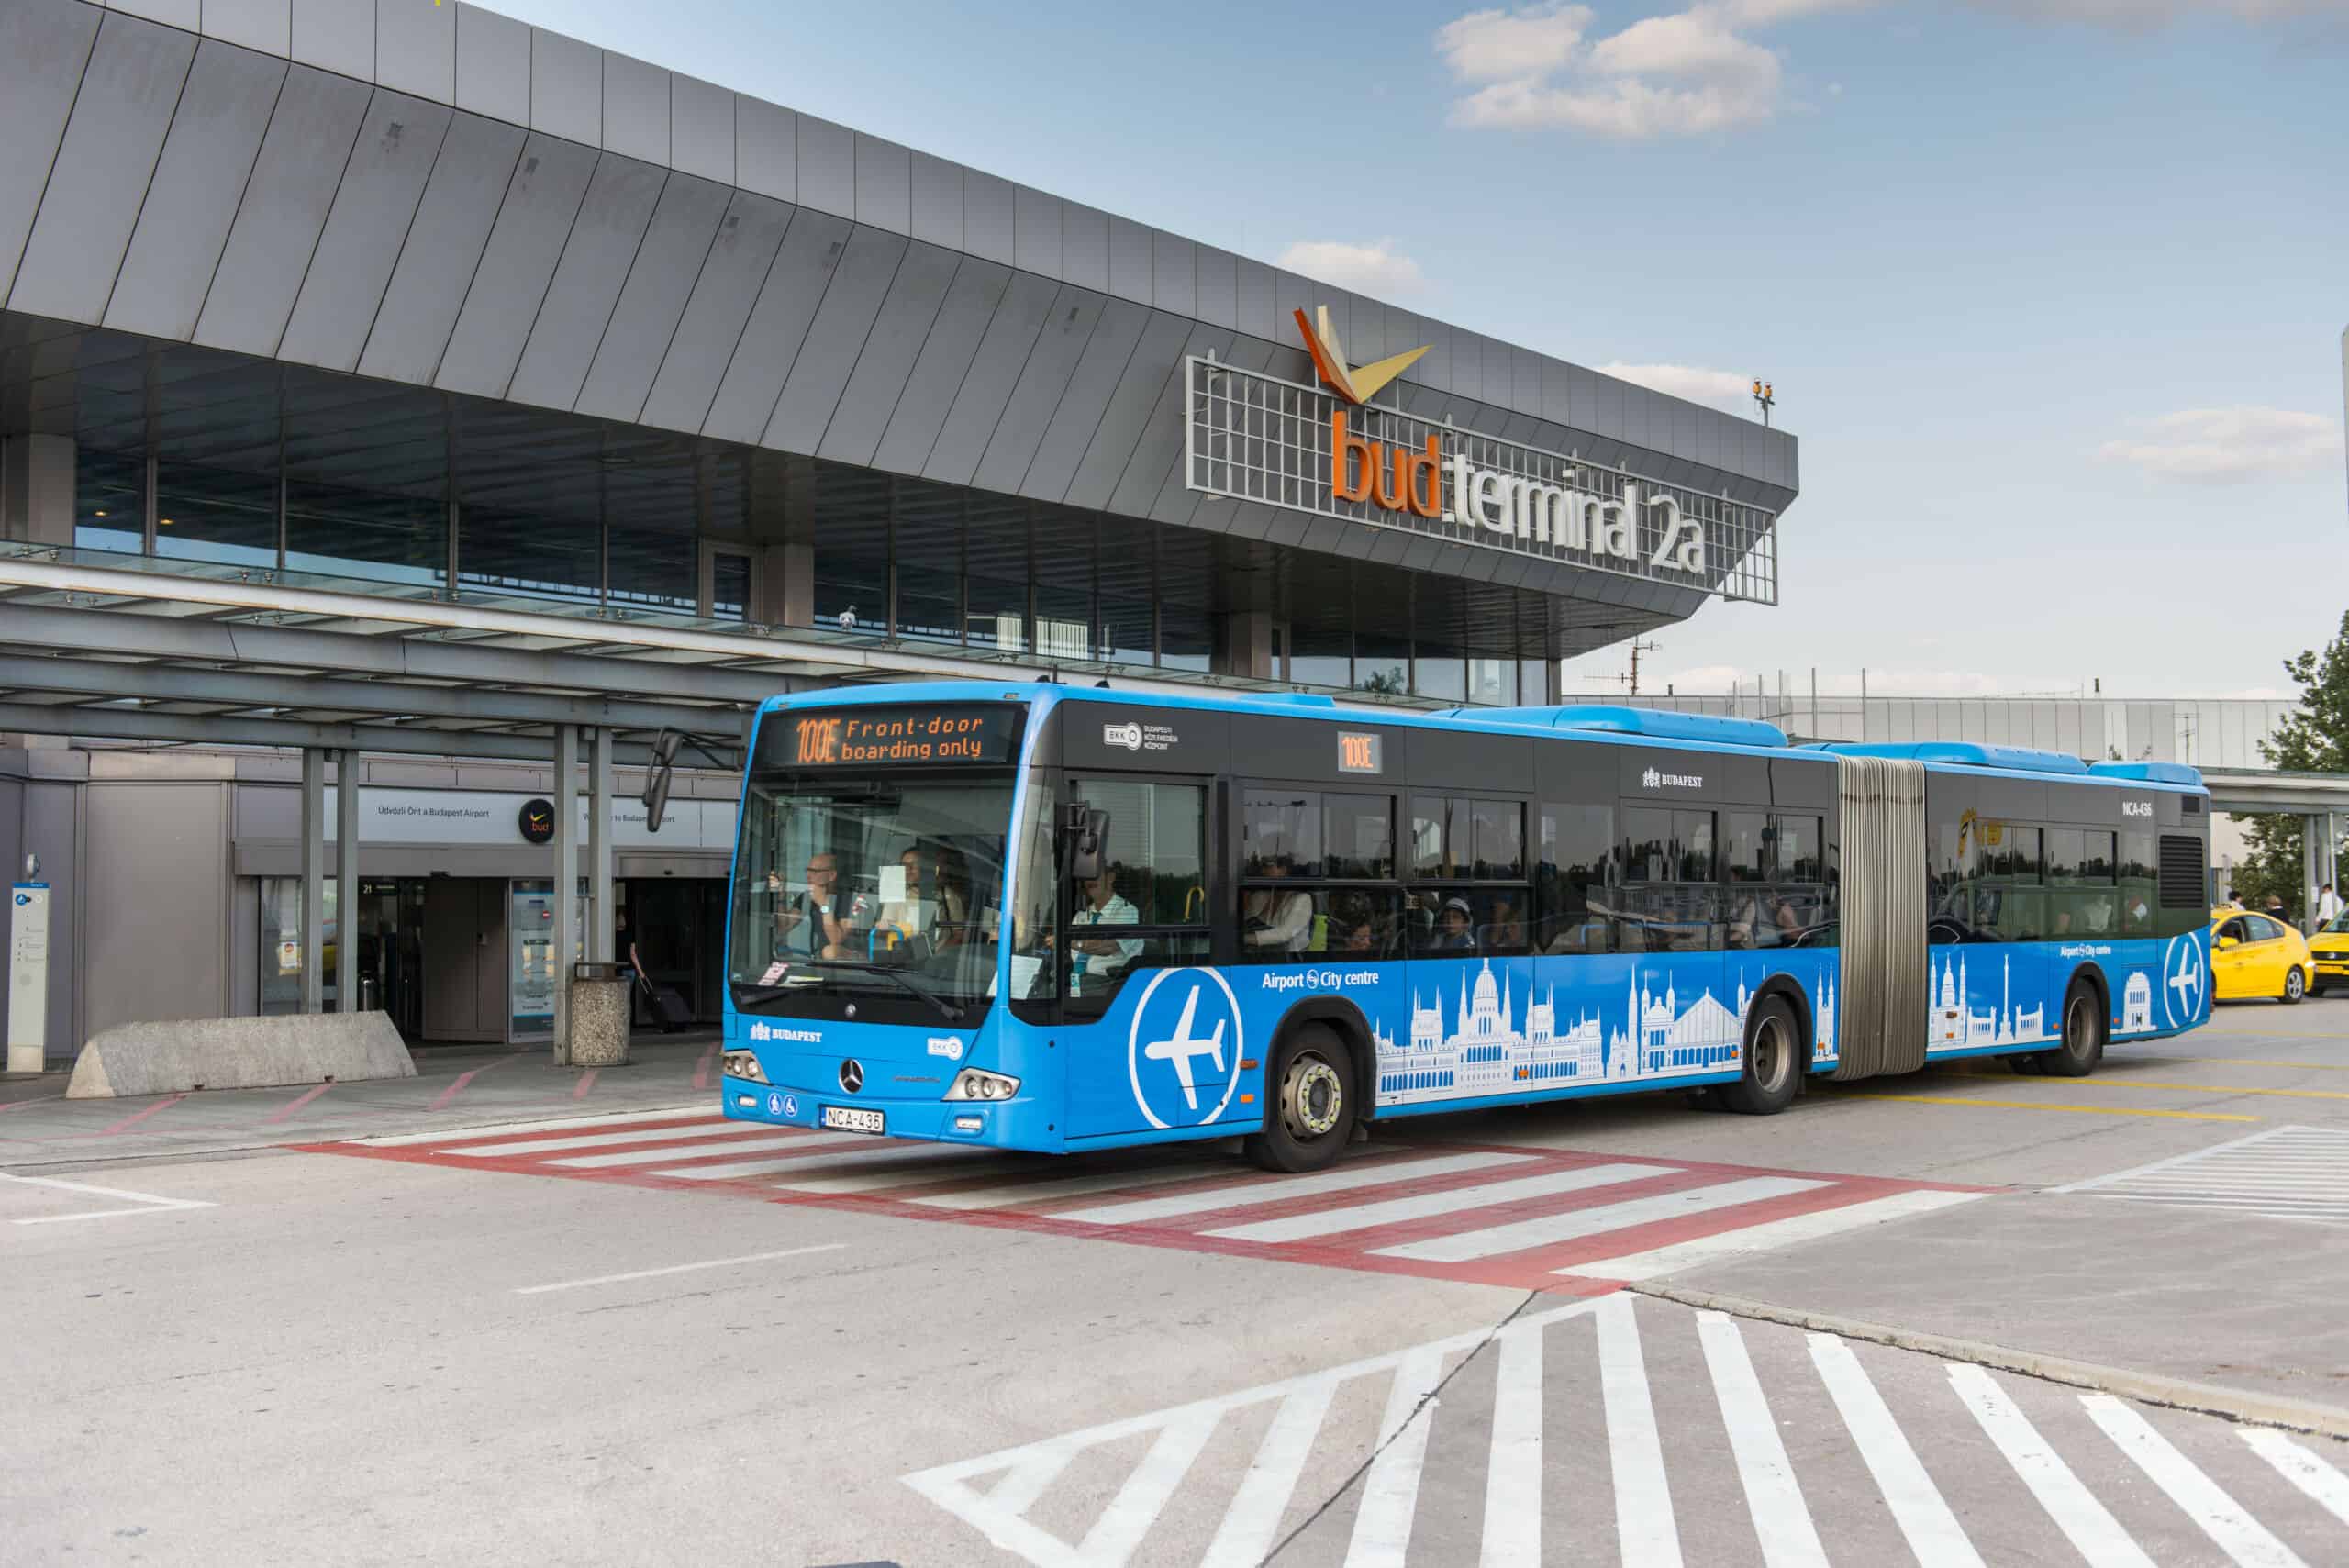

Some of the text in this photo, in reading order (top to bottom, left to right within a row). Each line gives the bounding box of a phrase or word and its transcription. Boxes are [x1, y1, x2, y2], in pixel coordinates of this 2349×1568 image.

[1650, 494, 1706, 575] 2a
[846, 716, 983, 738] Front-door
[796, 718, 841, 763] 100E
[841, 737, 983, 761] boarding only
[1342, 736, 1374, 769] 100E
[1662, 773, 1703, 788] BUDAPEST
[429, 807, 462, 818] Budapest
[464, 807, 490, 819] Airport
[2122, 801, 2152, 817] NCA-436
[531, 820, 549, 832] bud
[1263, 971, 1379, 992] Airport City centre
[773, 1028, 823, 1043] BUDAPEST
[828, 1109, 881, 1129] NCA-436
